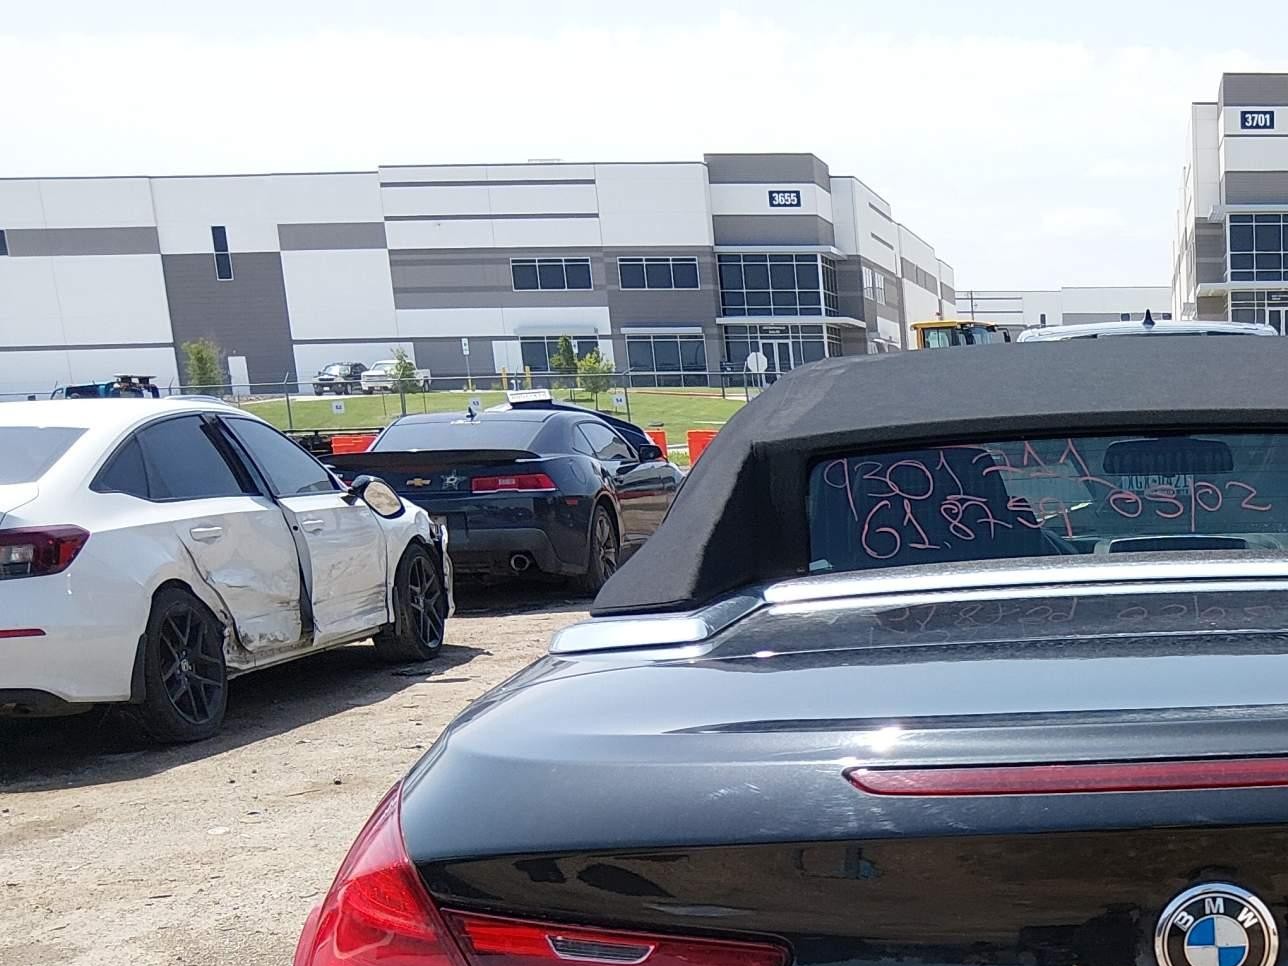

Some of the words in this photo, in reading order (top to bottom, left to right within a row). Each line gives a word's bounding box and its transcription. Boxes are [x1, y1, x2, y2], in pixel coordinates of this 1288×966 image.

[1244, 113, 1271, 127] 3701
[772, 193, 798, 205] 3655
[1173, 897, 1259, 933] BMW
